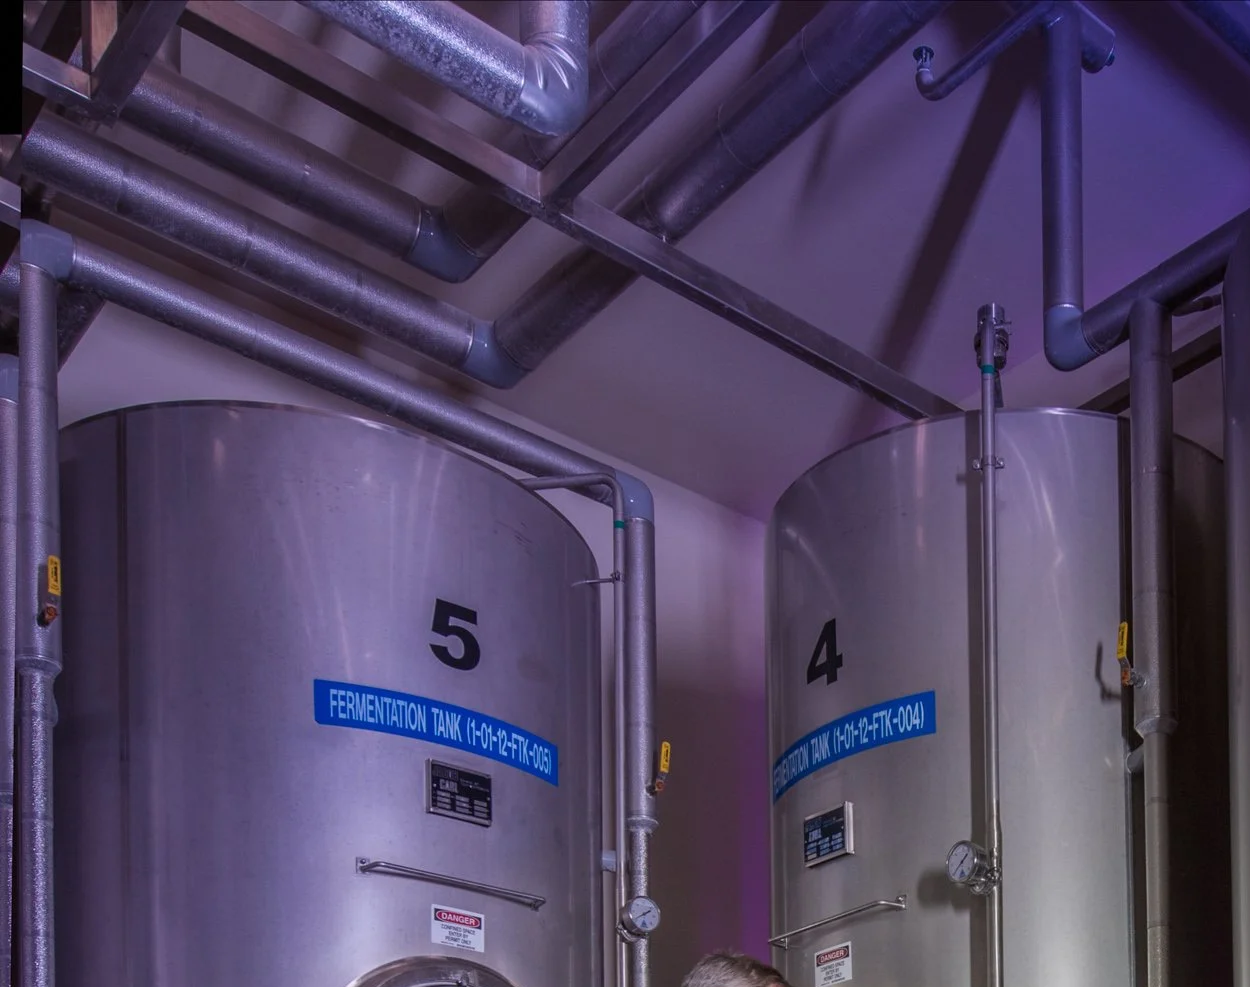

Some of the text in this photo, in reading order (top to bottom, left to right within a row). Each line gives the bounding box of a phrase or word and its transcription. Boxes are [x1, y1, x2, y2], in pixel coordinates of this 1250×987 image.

[429, 598, 481, 671] 5
[806, 618, 843, 686] 4
[329, 688, 552, 775] FERMENTATION TANK (1-01-12-FTK-005)
[810, 731, 831, 765] TANK
[833, 701, 925, 755] (1-01-12-FTK-004)
[441, 912, 475, 926] DANGER
[820, 949, 845, 964] DANGER
